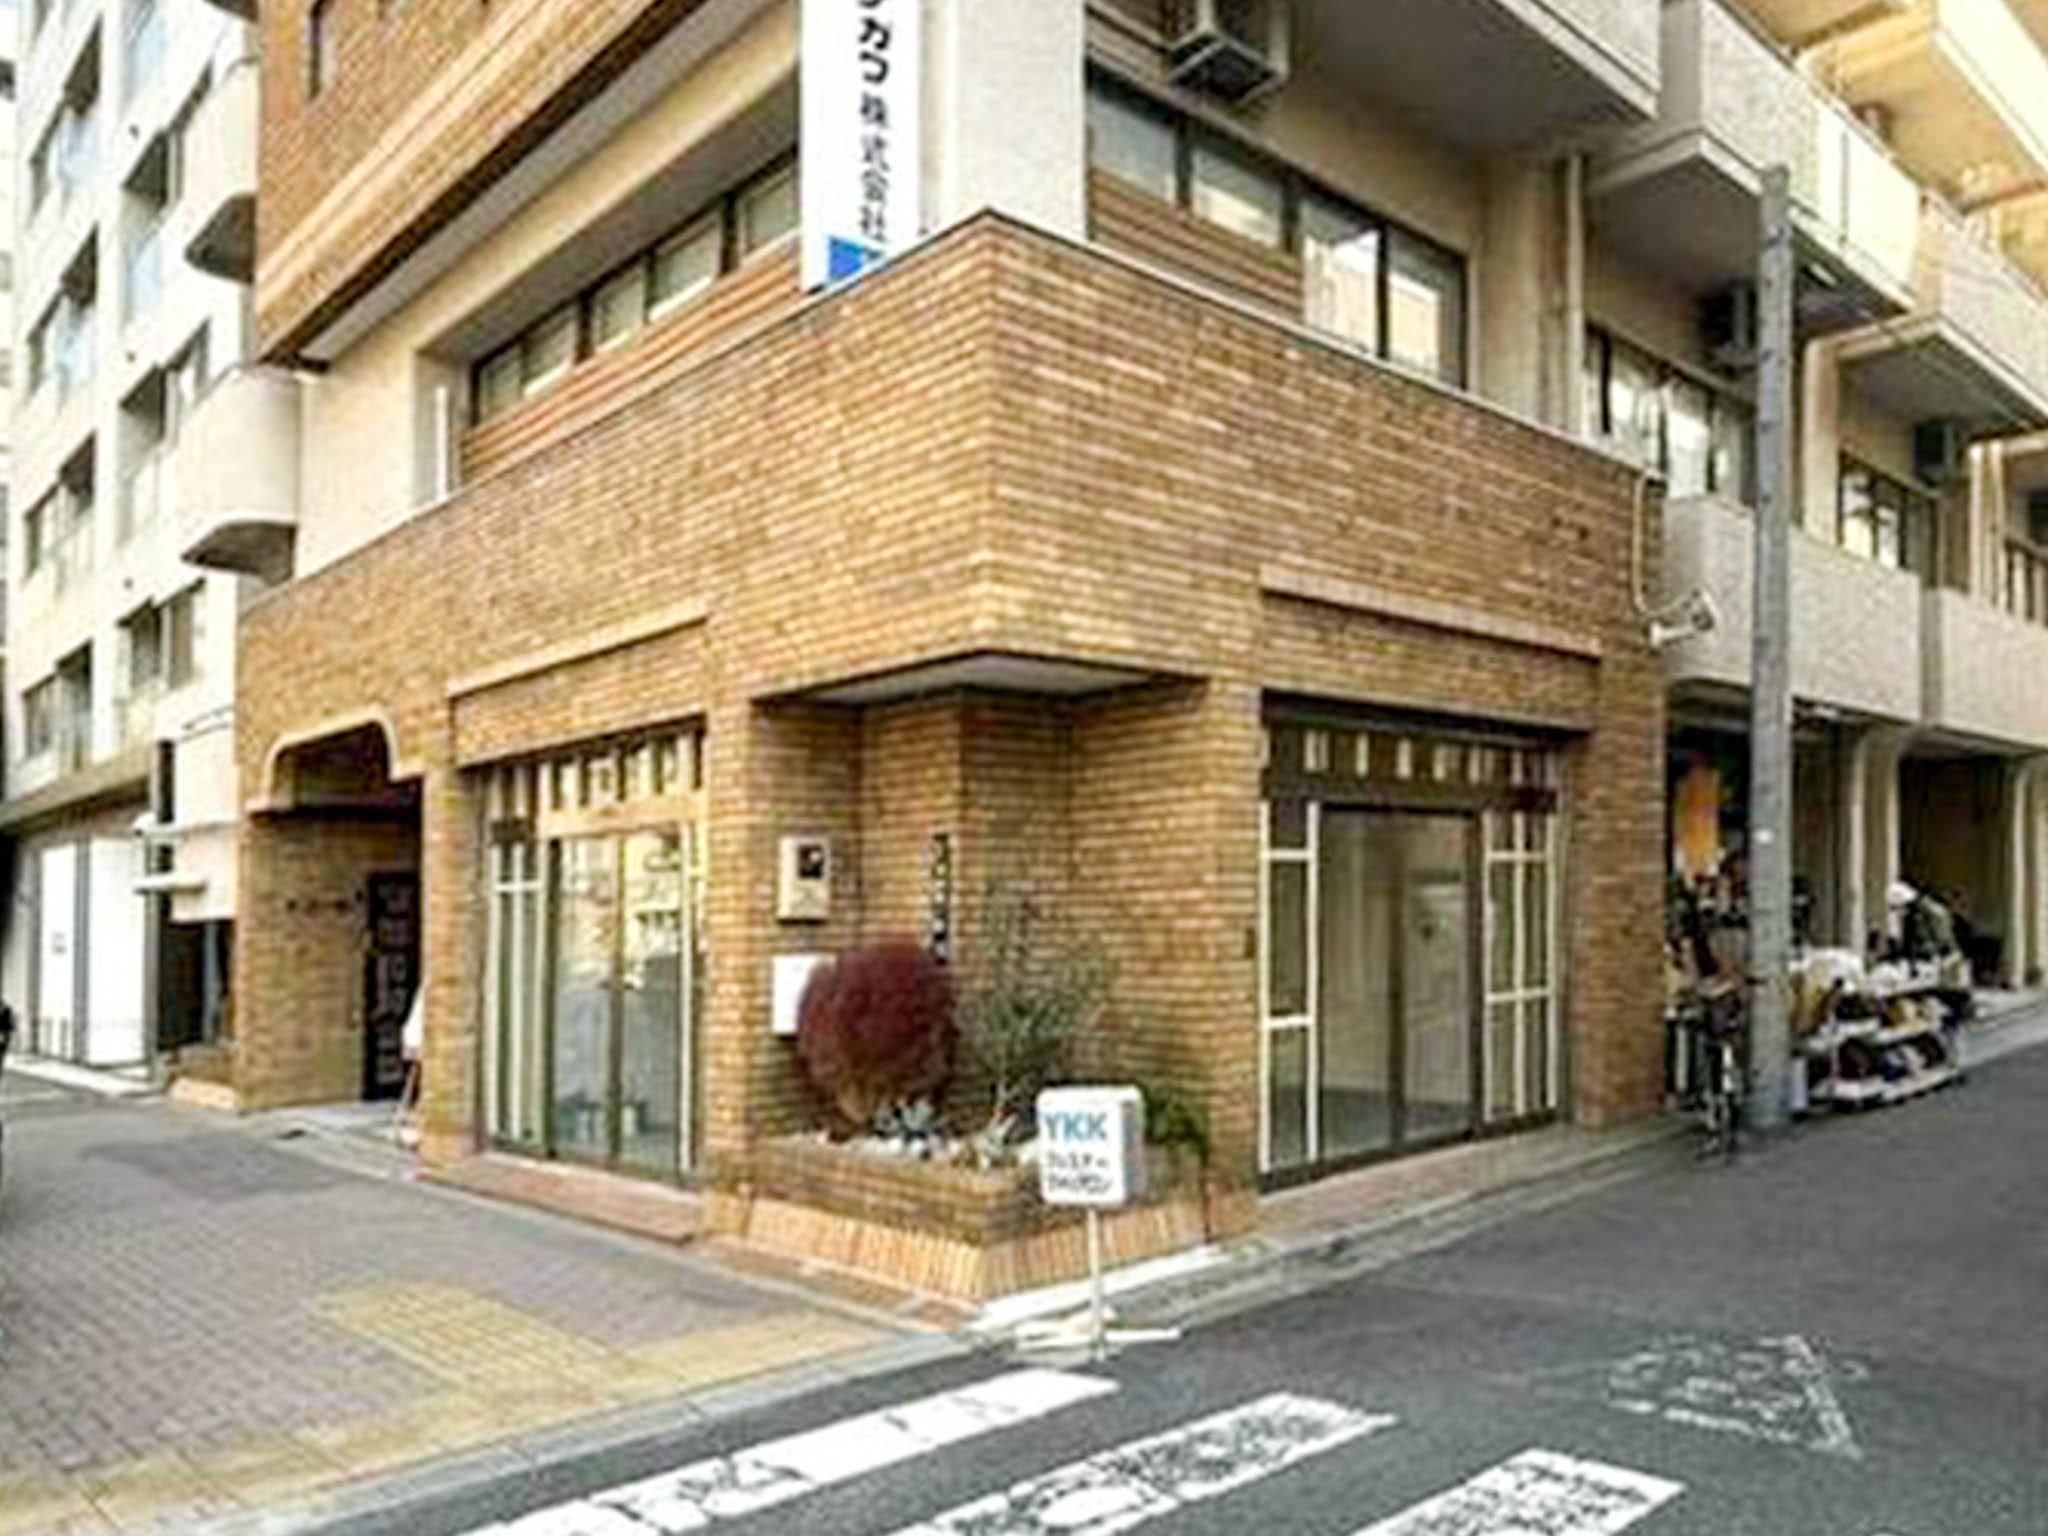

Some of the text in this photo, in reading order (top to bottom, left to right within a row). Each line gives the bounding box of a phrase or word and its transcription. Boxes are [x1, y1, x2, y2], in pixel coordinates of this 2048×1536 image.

[857, 0, 892, 242] カコ株式会社
[1042, 1111, 1108, 1142] YKK
